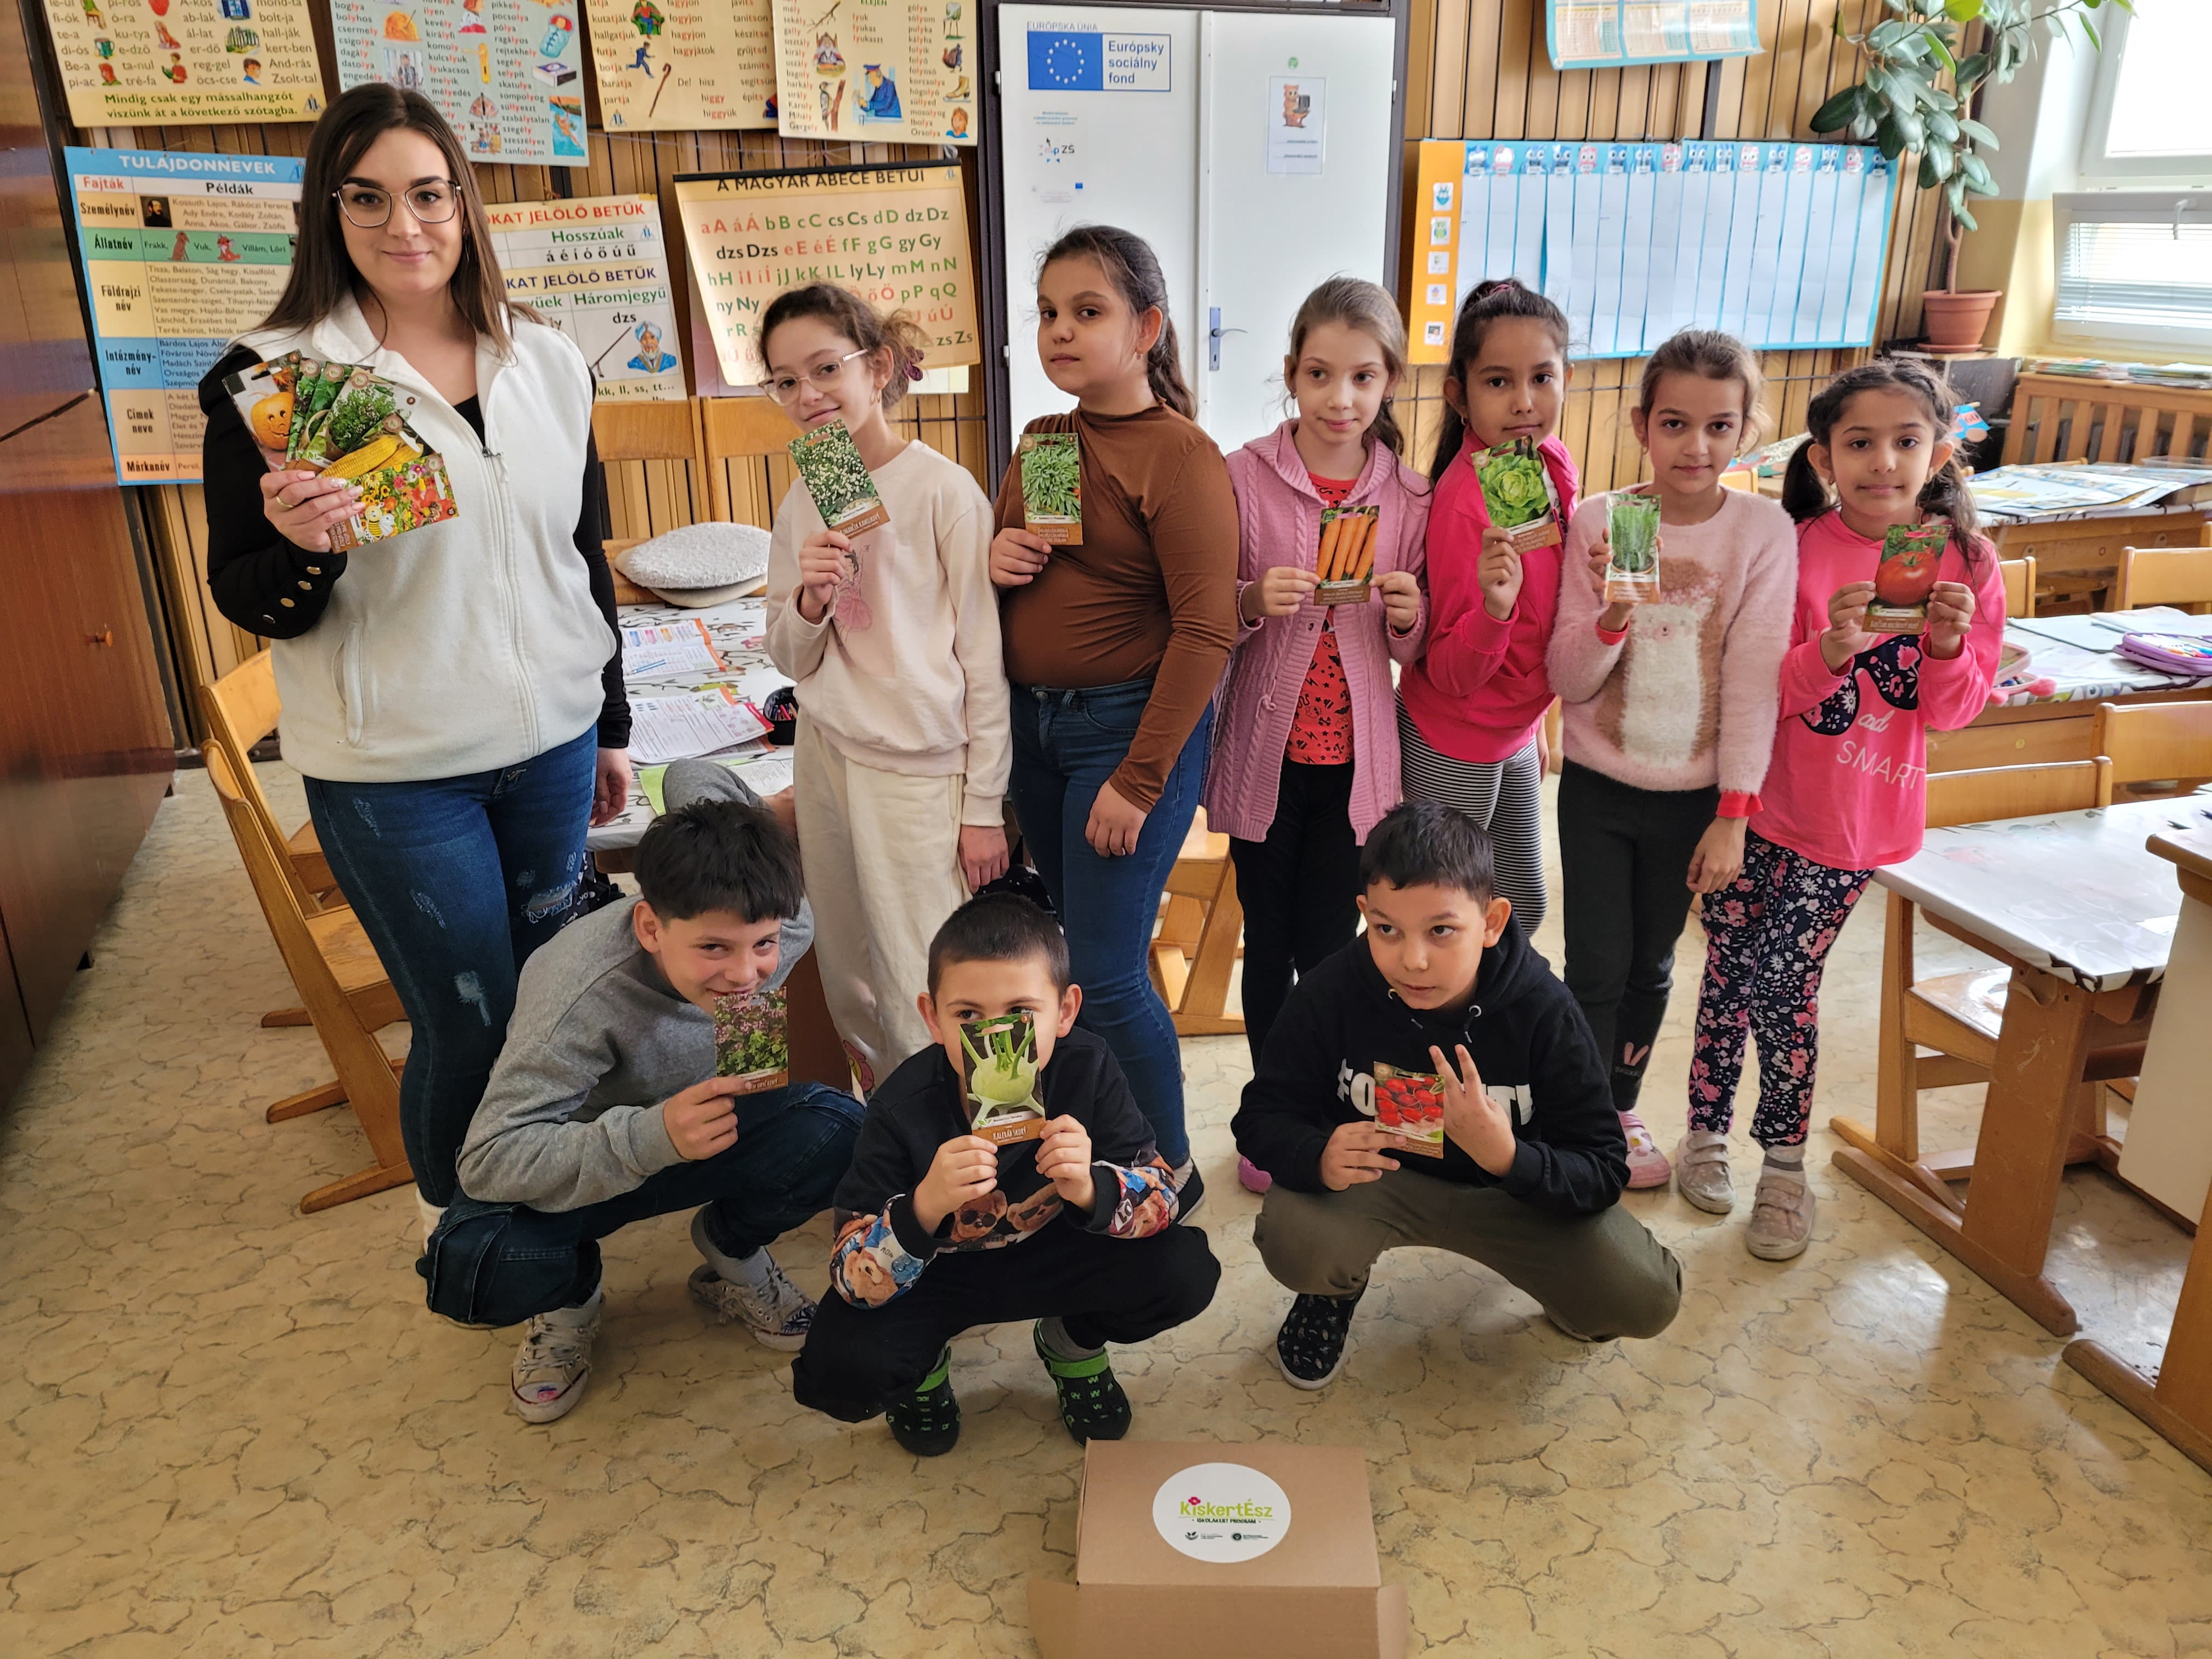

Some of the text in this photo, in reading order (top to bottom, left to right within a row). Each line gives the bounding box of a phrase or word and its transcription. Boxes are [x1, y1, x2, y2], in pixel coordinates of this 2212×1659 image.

[335, 2, 364, 12] boglya
[53, 14, 79, 23] fi-ók
[112, 13, 135, 22] ó-ra
[183, 13, 216, 22] ab-lak
[259, 13, 294, 24] bolt-ja
[336, 13, 372, 22] bolyhos
[493, 13, 528, 22] pocsolya
[592, 15, 628, 24] kutatják
[669, 14, 702, 24] fogyjon
[338, 26, 378, 36] csermely
[1027, 21, 1097, 31] EURÓPSKA ÚNIA
[58, 30, 79, 39] te-a
[115, 29, 150, 40] ku-tya
[187, 29, 213, 37] ál-lat
[263, 27, 300, 39] hall-ják
[426, 30, 455, 41] királyfi
[595, 31, 636, 41] hallgatjuk
[495, 35, 528, 45] ragályos
[61, 45, 89, 55] di-ós
[119, 44, 150, 54] e-dző
[190, 44, 220, 53] er-dő
[266, 44, 312, 53] kert-ben
[427, 42, 459, 52] komoly
[674, 47, 714, 57] hagyjátok
[1109, 40, 1164, 55] Európsky
[496, 47, 536, 58] rejtekhely
[270, 59, 311, 68] And-rás
[428, 53, 467, 64] kulcslyuk
[65, 61, 90, 70] Be-a
[122, 60, 154, 70] ta-nul
[193, 59, 230, 72] reg-gel
[342, 60, 375, 70] datolya
[1109, 58, 1157, 71] sociálny
[430, 65, 470, 75] lyukacsos
[498, 69, 524, 78] selypít
[126, 76, 156, 86] tré-fa
[197, 75, 236, 84] öcs-cse
[272, 74, 317, 83] Zsolt-tal
[343, 72, 382, 82] engedély
[1109, 72, 1135, 83] fond
[69, 77, 95, 89] pi-ac
[499, 81, 532, 91] skatulya
[602, 79, 632, 89] barátja
[678, 78, 714, 87] De! hisz
[432, 88, 471, 97] mélyedés
[500, 92, 544, 103] sompolyog
[105, 92, 294, 105] Mindig csak egy mássalhangzót
[604, 96, 630, 105] partja
[433, 99, 461, 109] milyen
[501, 103, 535, 114] süllyeszt
[108, 109, 150, 119] viszünk
[155, 108, 165, 117] át
[181, 106, 240, 116] következő
[245, 106, 297, 116] szótagba.
[703, 110, 736, 119] higgyük
[502, 115, 549, 125] szabálytalan
[504, 137, 545, 146] szeszélyes
[505, 148, 544, 157] tanfolyam
[119, 155, 275, 174] TULAJDONNEVEK
[83, 177, 124, 191] Fajták
[206, 182, 253, 195] Példák
[717, 179, 730, 191] A
[735, 176, 810, 191] MAGYAR
[81, 202, 134, 218] Személynév
[529, 204, 587, 225] JELÖLŐ
[594, 201, 645, 218] BETŰK
[551, 227, 624, 243] Hosszúak
[95, 234, 132, 250] Állatnév
[547, 244, 636, 262] á é í ó ő ú ű
[543, 269, 600, 289] JELÖLŐ
[606, 266, 656, 282] BETŰK
[101, 285, 140, 300] Földrajzi
[574, 287, 666, 305] Háromjegyű
[116, 300, 131, 311] név
[613, 312, 636, 324] dzs
[126, 365, 140, 374] név
[127, 409, 154, 420] Címek
[133, 424, 153, 433] neve
[127, 461, 170, 472] Márkanév
[1837, 741, 1925, 789] SMART
[1180, 1498, 1272, 1517] KiskertÉsz
